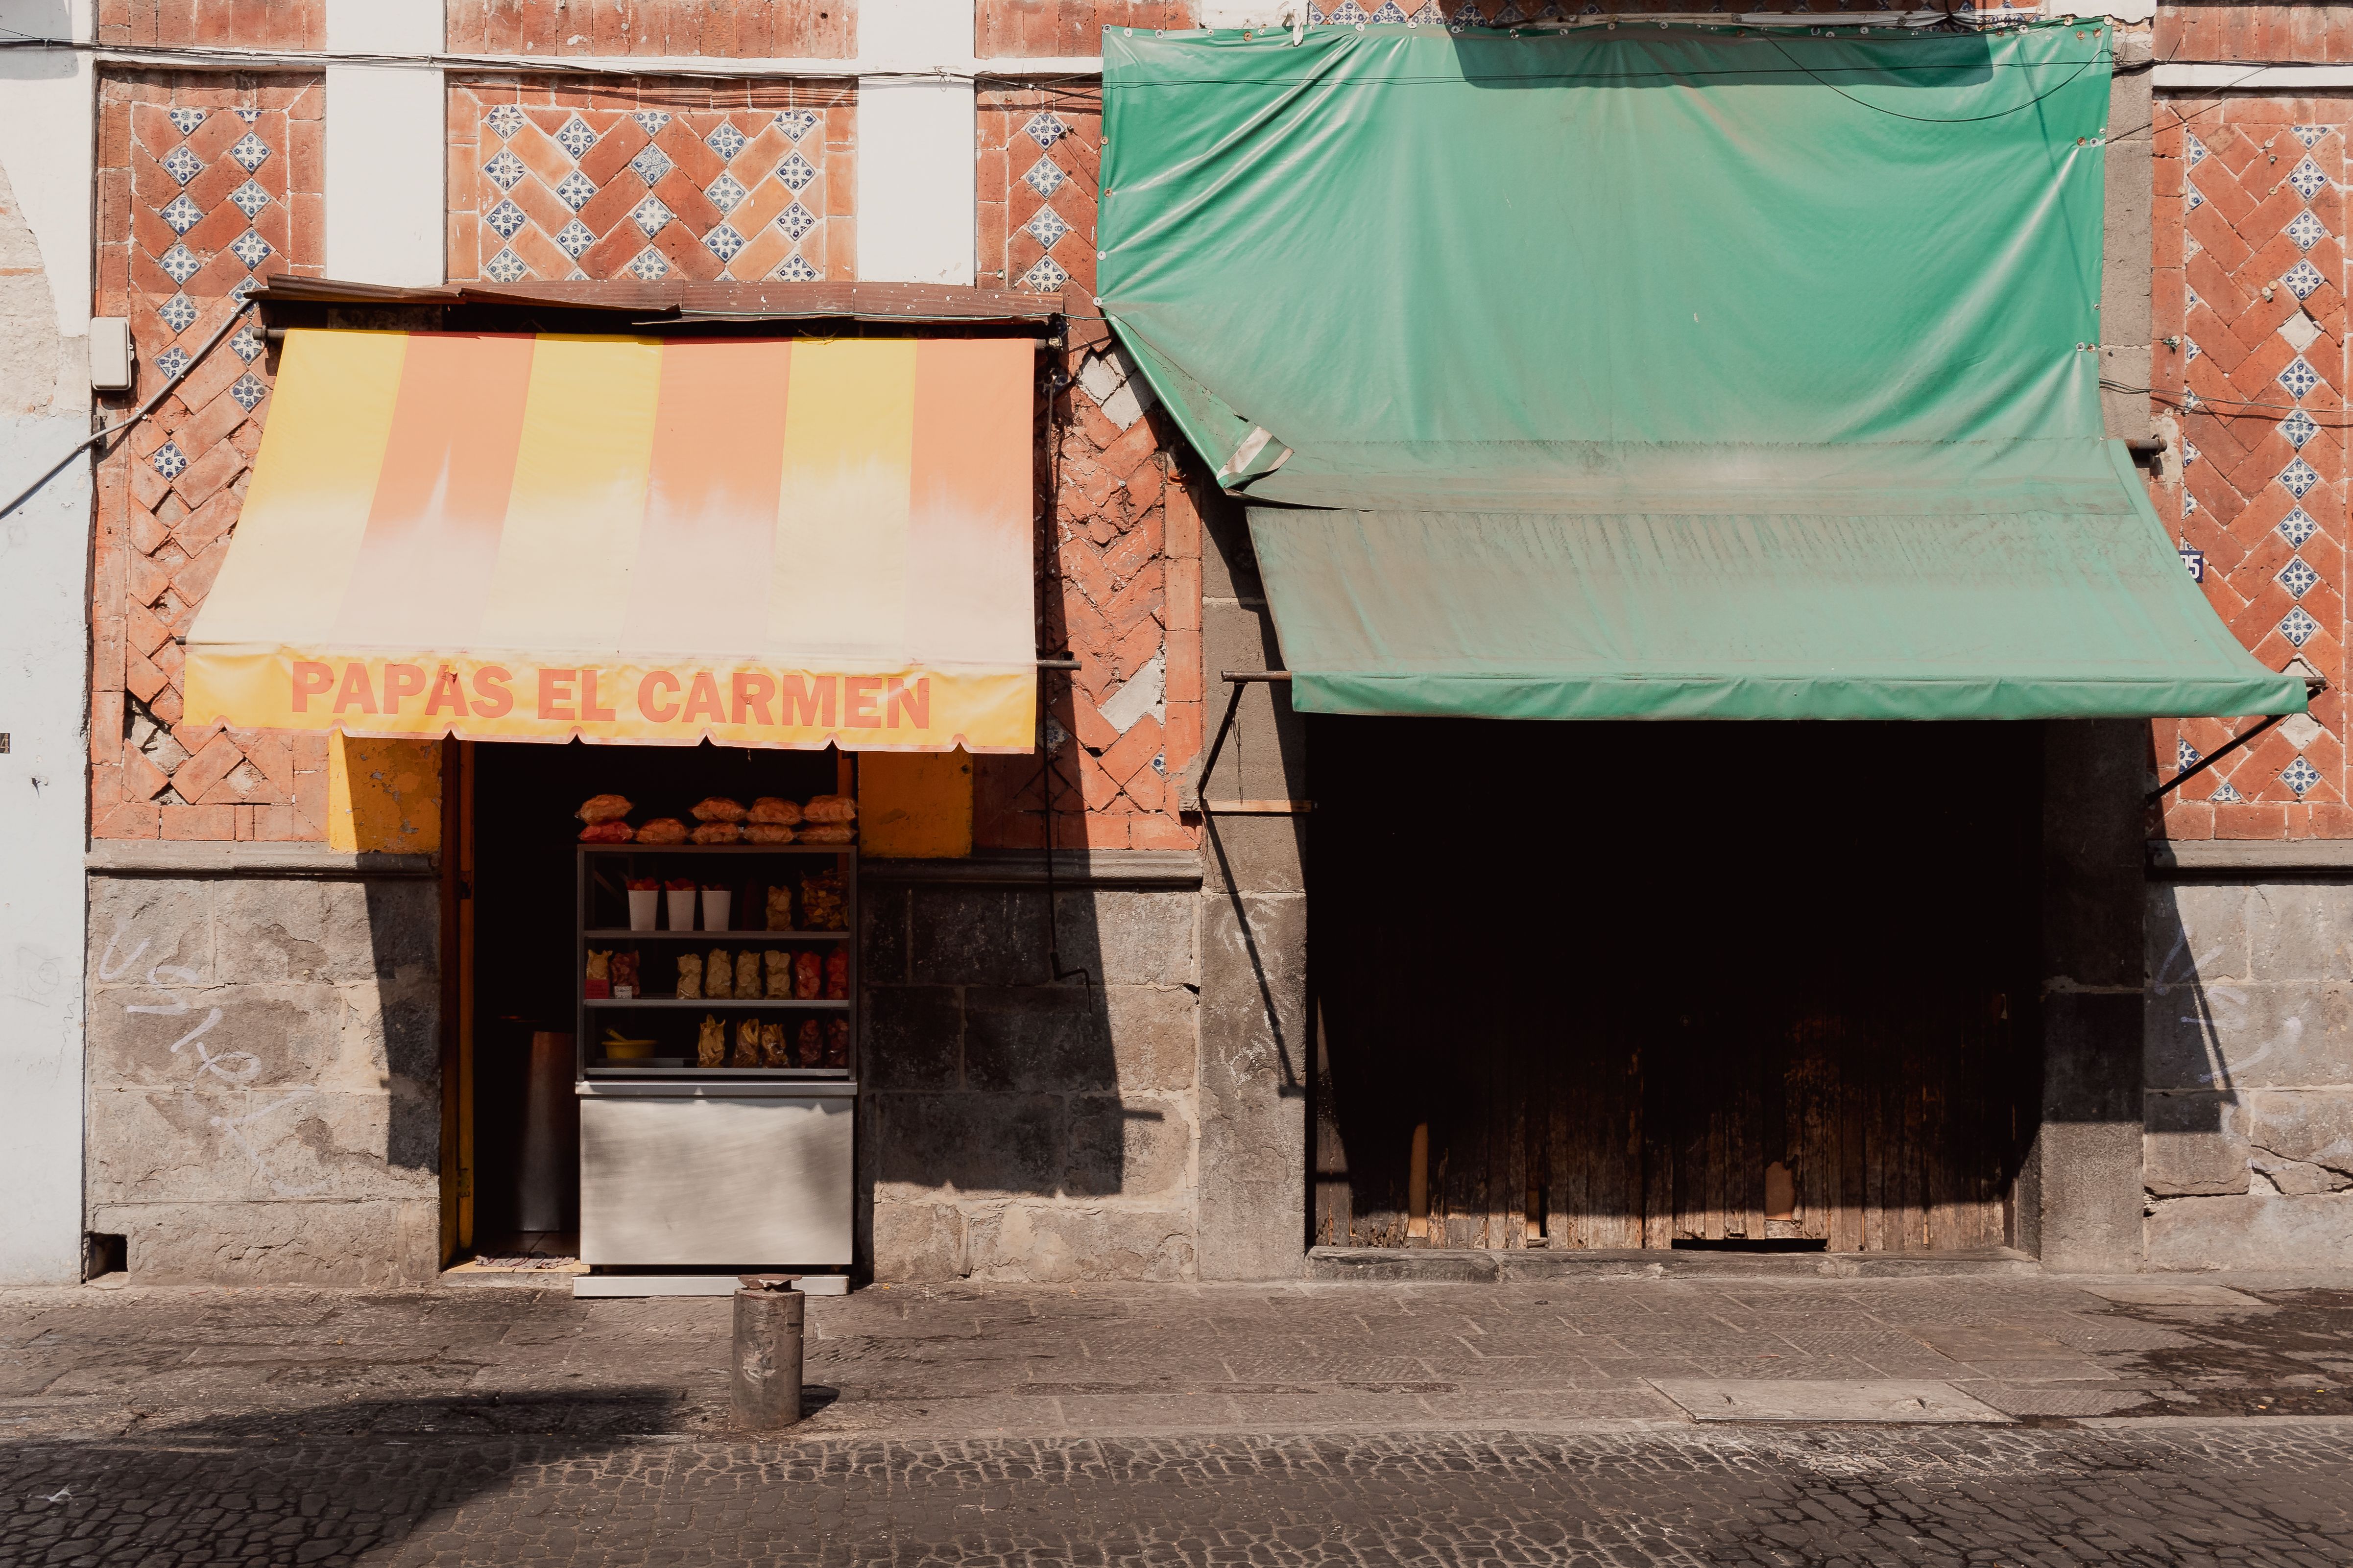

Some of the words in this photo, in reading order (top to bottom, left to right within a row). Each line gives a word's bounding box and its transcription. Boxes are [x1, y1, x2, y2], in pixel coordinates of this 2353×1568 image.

[292, 661, 514, 718] PAPAS
[537, 668, 616, 721] EL
[638, 670, 930, 729] CARMEN
